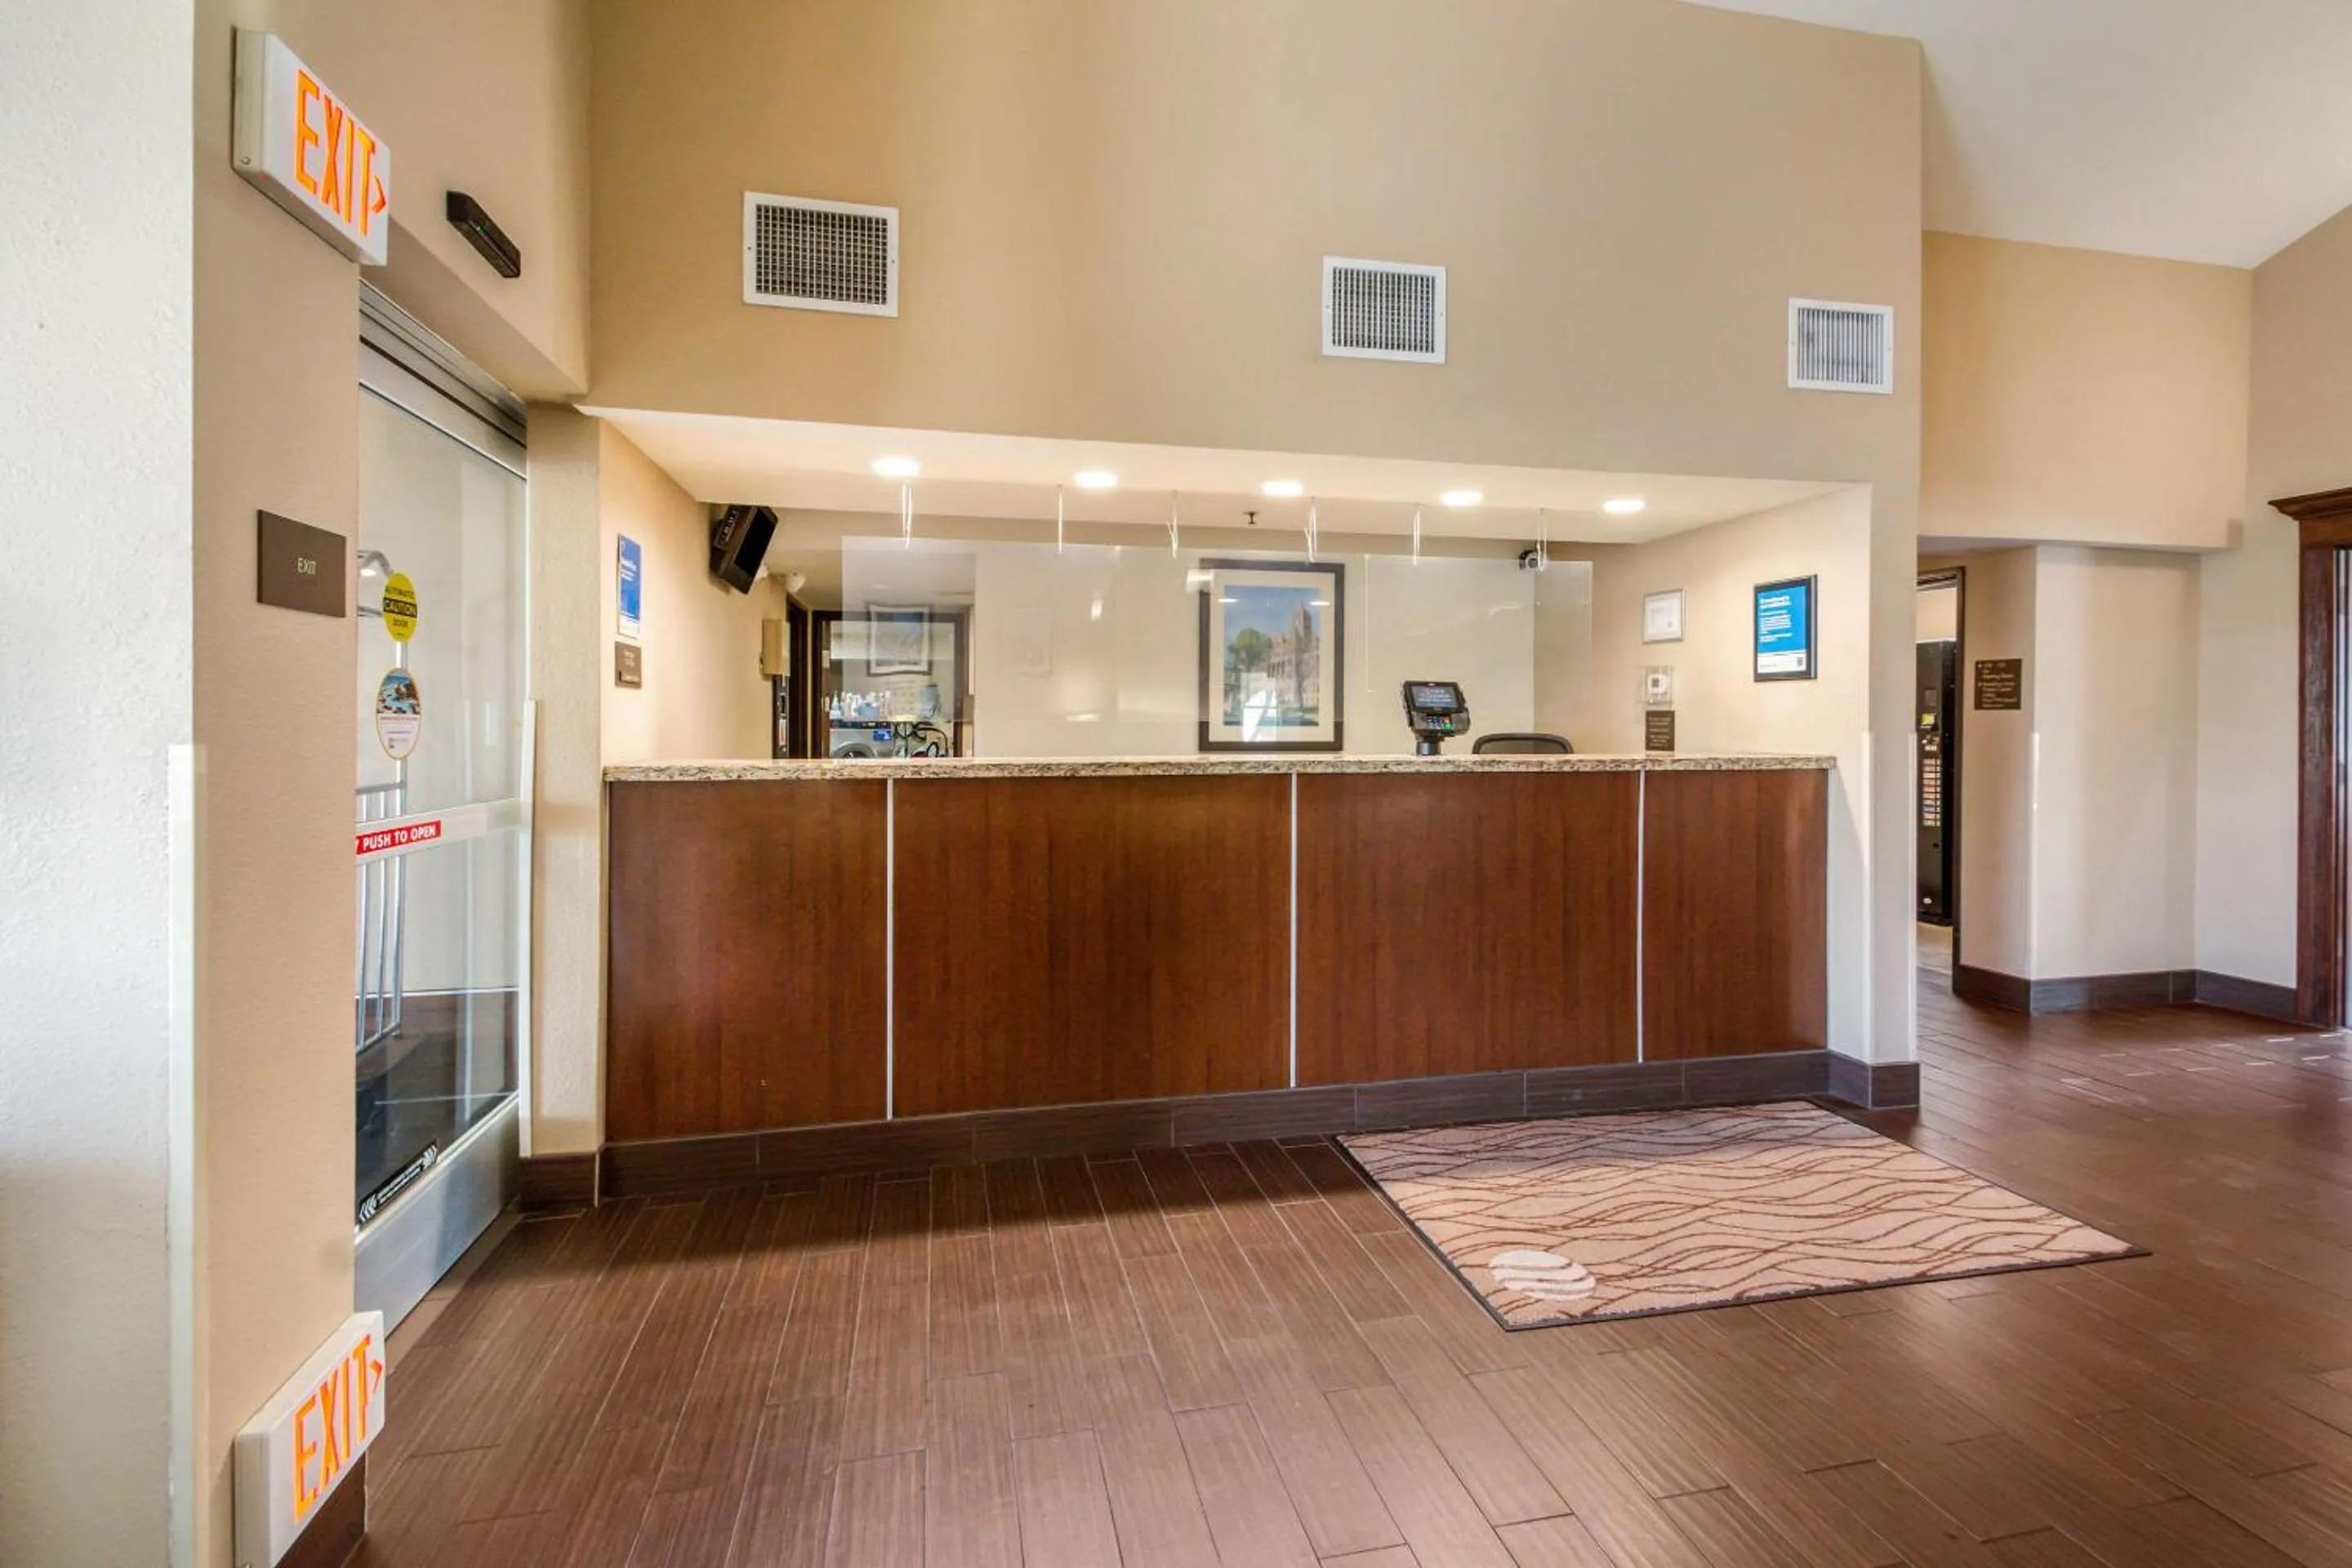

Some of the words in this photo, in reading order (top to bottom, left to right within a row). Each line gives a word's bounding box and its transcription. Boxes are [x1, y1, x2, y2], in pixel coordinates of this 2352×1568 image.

[296, 69, 376, 236] EXIT
[296, 557, 316, 575] EXIT
[385, 599, 416, 616] CAUTION
[363, 835, 391, 849] PUSH
[395, 831, 408, 844] TO
[412, 825, 435, 840] OPEN
[294, 1333, 371, 1523] EXIT
